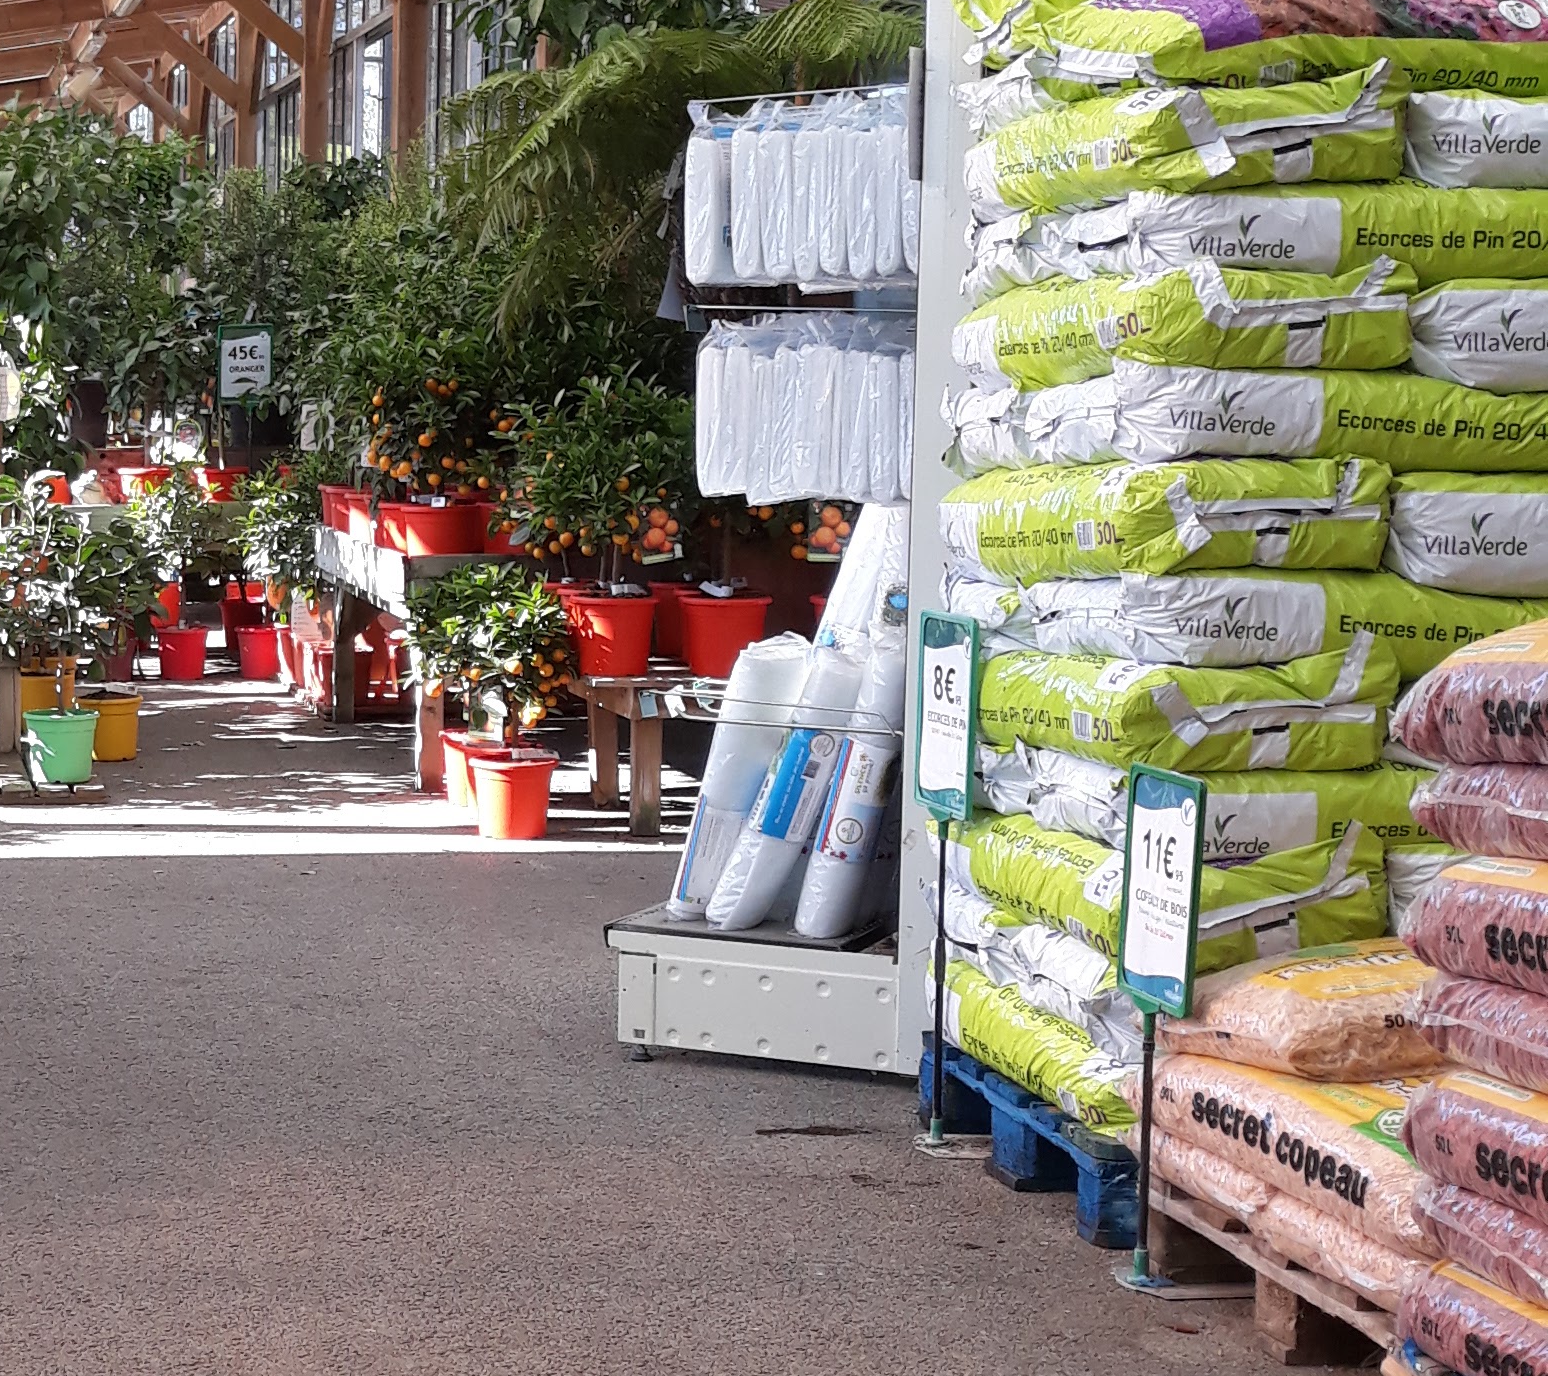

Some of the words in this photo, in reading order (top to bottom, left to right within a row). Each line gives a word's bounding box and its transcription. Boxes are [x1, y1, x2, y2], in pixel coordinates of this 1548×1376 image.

[1504, 75, 1540, 90] mm
[1431, 133, 1542, 155] VillaVerde
[1188, 235, 1296, 260] VillaVerde
[1355, 227, 1434, 249] Ecorces
[1441, 230, 1465, 249] de
[1473, 230, 1504, 249] Pin
[1512, 230, 1548, 251] 20/
[1453, 331, 1548, 352] VillaVerd
[1169, 407, 1276, 437] VillaVerde
[1338, 409, 1416, 434] Ecorces
[1424, 419, 1447, 437] de
[1453, 419, 1485, 439] Pin
[1422, 534, 1528, 557] VillaVerde
[1174, 617, 1278, 642] VillaVerde
[1339, 615, 1416, 640] Ecorces
[1424, 622, 1447, 642] de
[1482, 698, 1548, 737] secr
[1143, 828, 1177, 880] 11€
[1202, 836, 1270, 855] aVerde
[1484, 923, 1548, 974] secr
[1191, 1091, 1272, 1155] secret
[1275, 1131, 1369, 1209] copeau
[1475, 1141, 1548, 1204] secr
